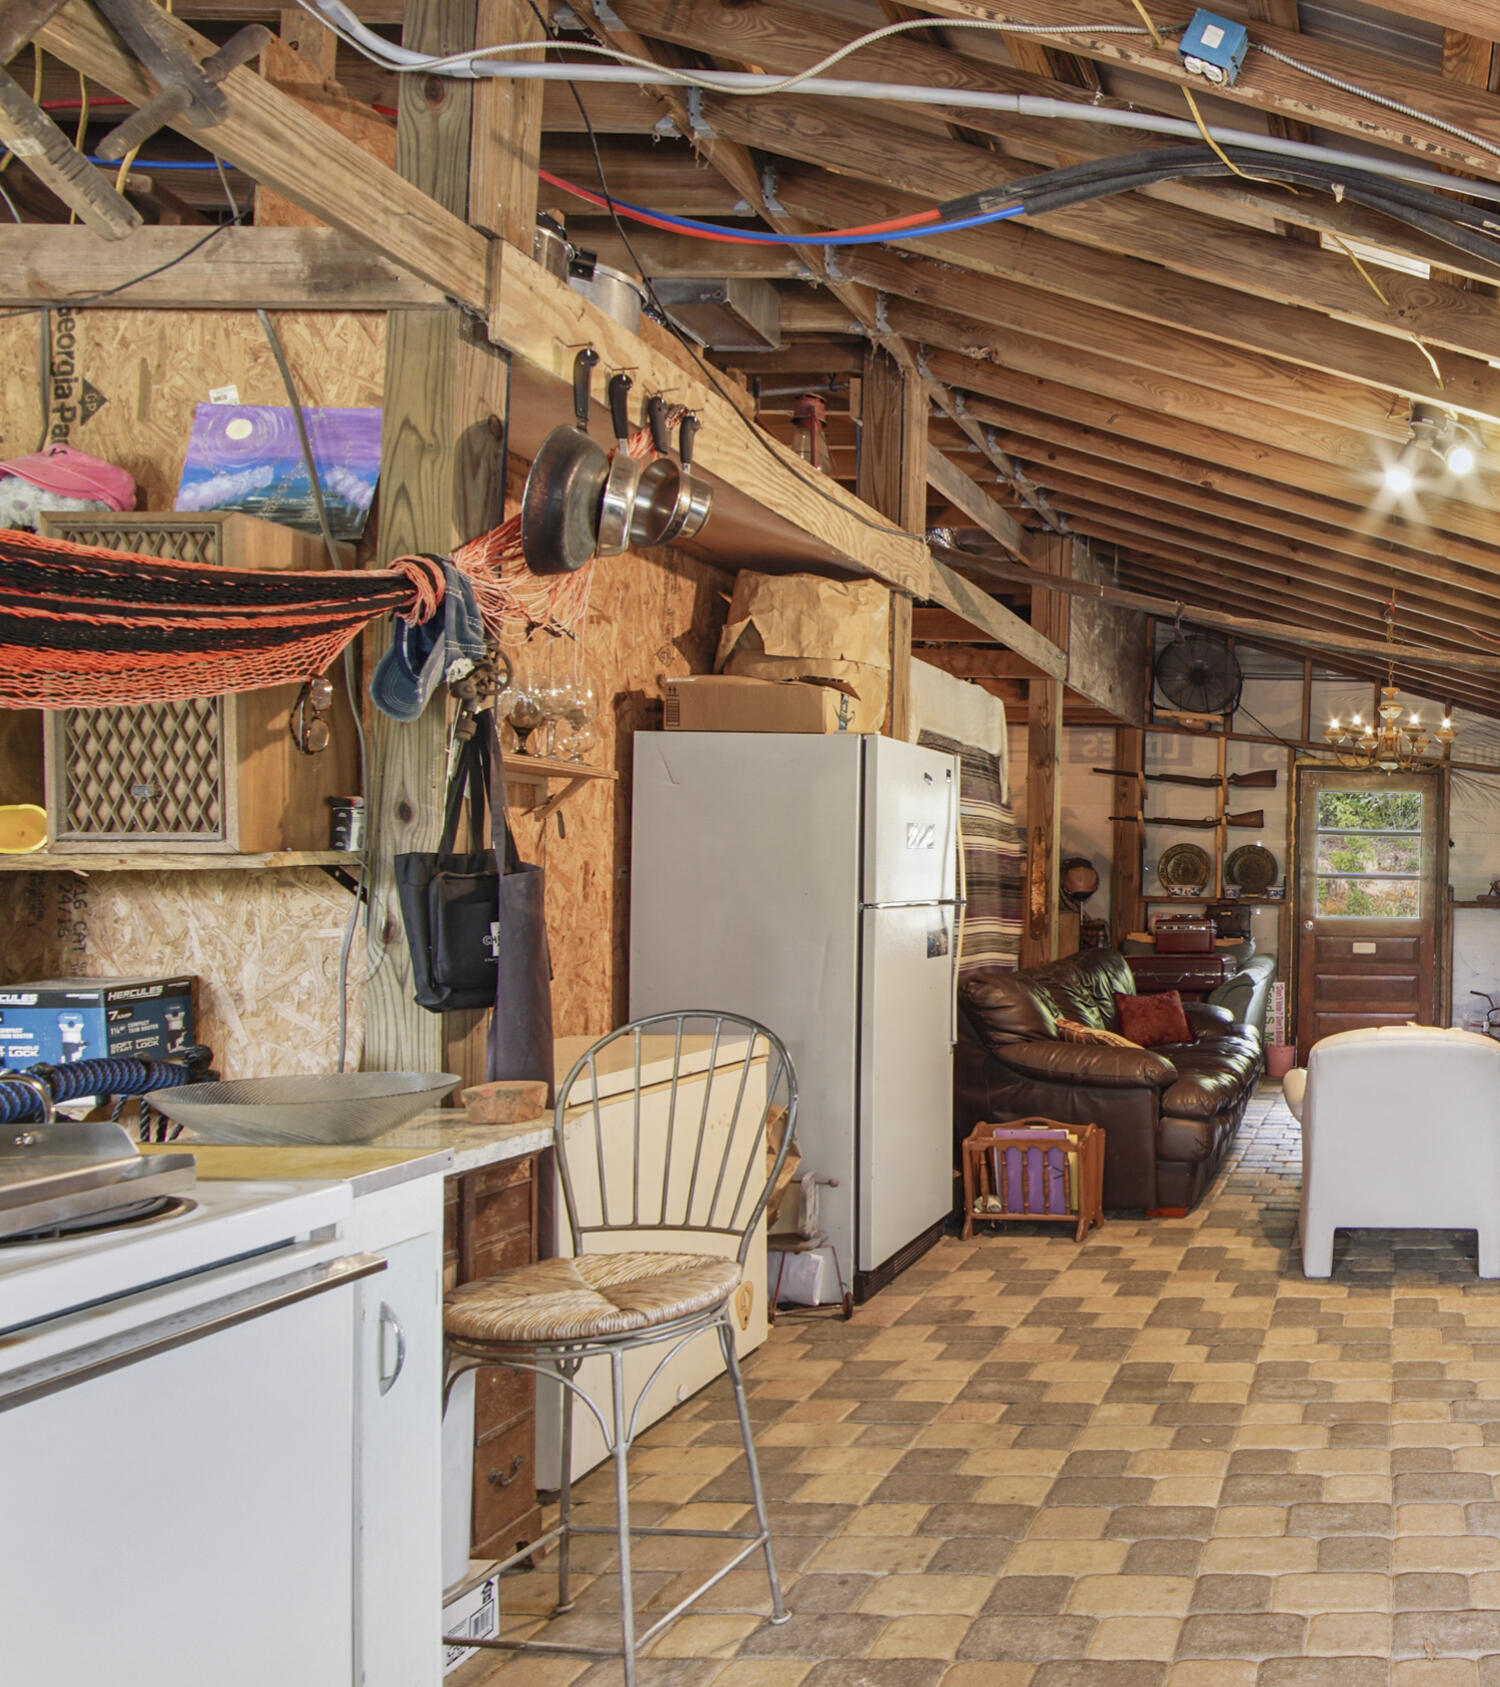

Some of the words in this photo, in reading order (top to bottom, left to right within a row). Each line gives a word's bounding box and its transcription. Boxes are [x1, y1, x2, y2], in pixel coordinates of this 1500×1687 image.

[72, 921, 87, 952] CAT
[107, 985, 164, 1001] HERCULES
[108, 1010, 119, 1021] 7
[136, 1040, 160, 1050] LOCK
[8, 1050, 40, 1058] LOCK
